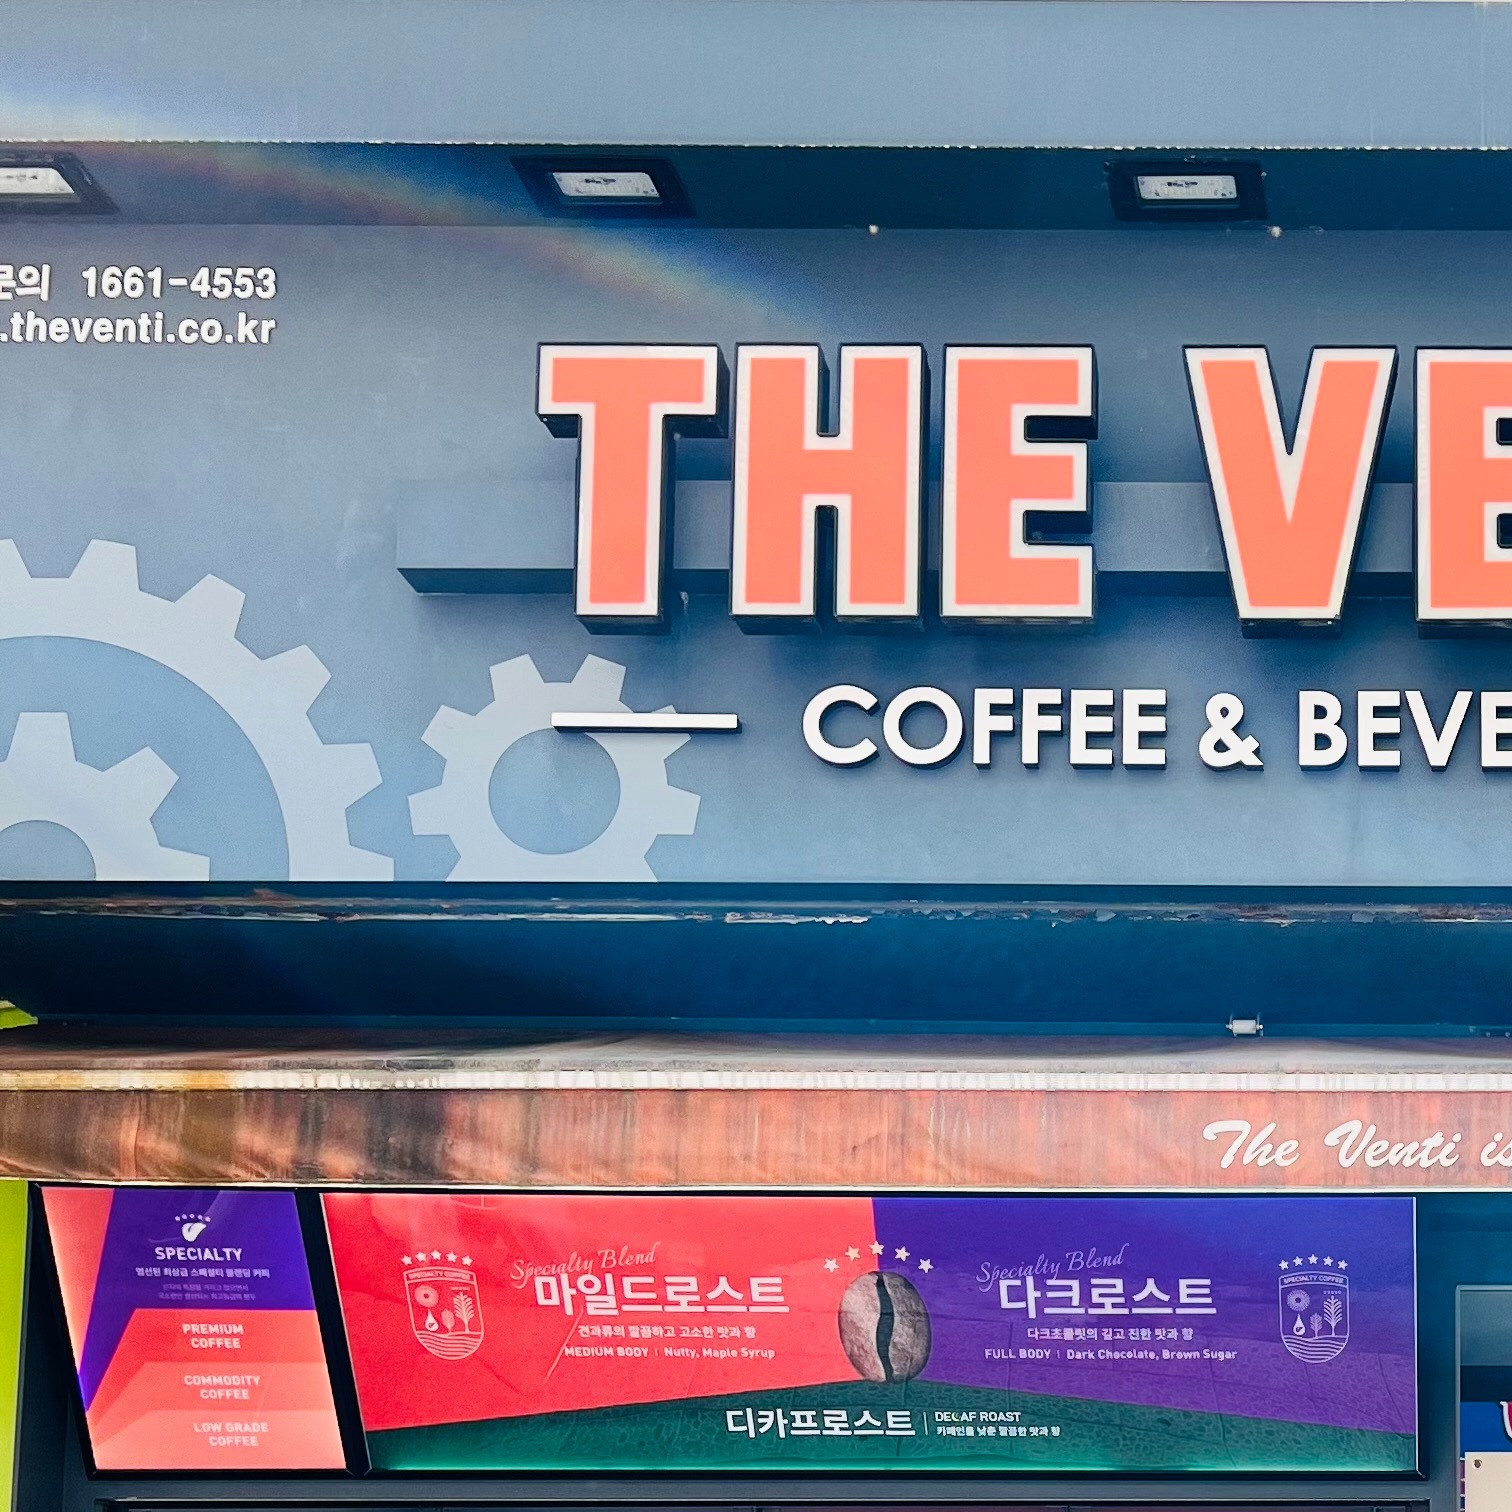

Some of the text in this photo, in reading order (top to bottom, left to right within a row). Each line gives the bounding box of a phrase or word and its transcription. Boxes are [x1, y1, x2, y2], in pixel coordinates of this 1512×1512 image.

[81, 264, 277, 300] 1661-4553
[538, 343, 1095, 622] THE
[801, 684, 1168, 770] COFFEE
[1198, 690, 1264, 770] &
[1202, 1118, 1300, 1169] The
[1323, 1118, 1461, 1169] Venti
[154, 1246, 242, 1262] SPECIALTY
[509, 1241, 661, 1290] Specialty Blend
[976, 1242, 1130, 1292] Specialty Blend
[533, 1271, 790, 1317] 마일드로스트
[999, 1276, 1217, 1319] 다크로스트
[182, 1323, 244, 1335] PREMIUM
[679, 1324, 716, 1340] 고소한
[717, 1324, 741, 1340] 맛과
[1128, 1327, 1152, 1341] 진한
[1154, 1327, 1179, 1341] 맛과
[190, 1337, 242, 1349] COFFEE
[564, 1346, 776, 1360] MEDIUM BODY Nutty, Maple Syrup
[984, 1348, 1238, 1362] FULL BODY Dark Chocolate, Brown Sugar
[184, 1375, 260, 1386] COMMODITY
[200, 1389, 250, 1400] COFFEE
[725, 1407, 916, 1439] 디카프로스트
[934, 1411, 1022, 1422] DECAF ROAST
[193, 1422, 269, 1433] LOW GRADE
[209, 1435, 258, 1447] COFFEE
